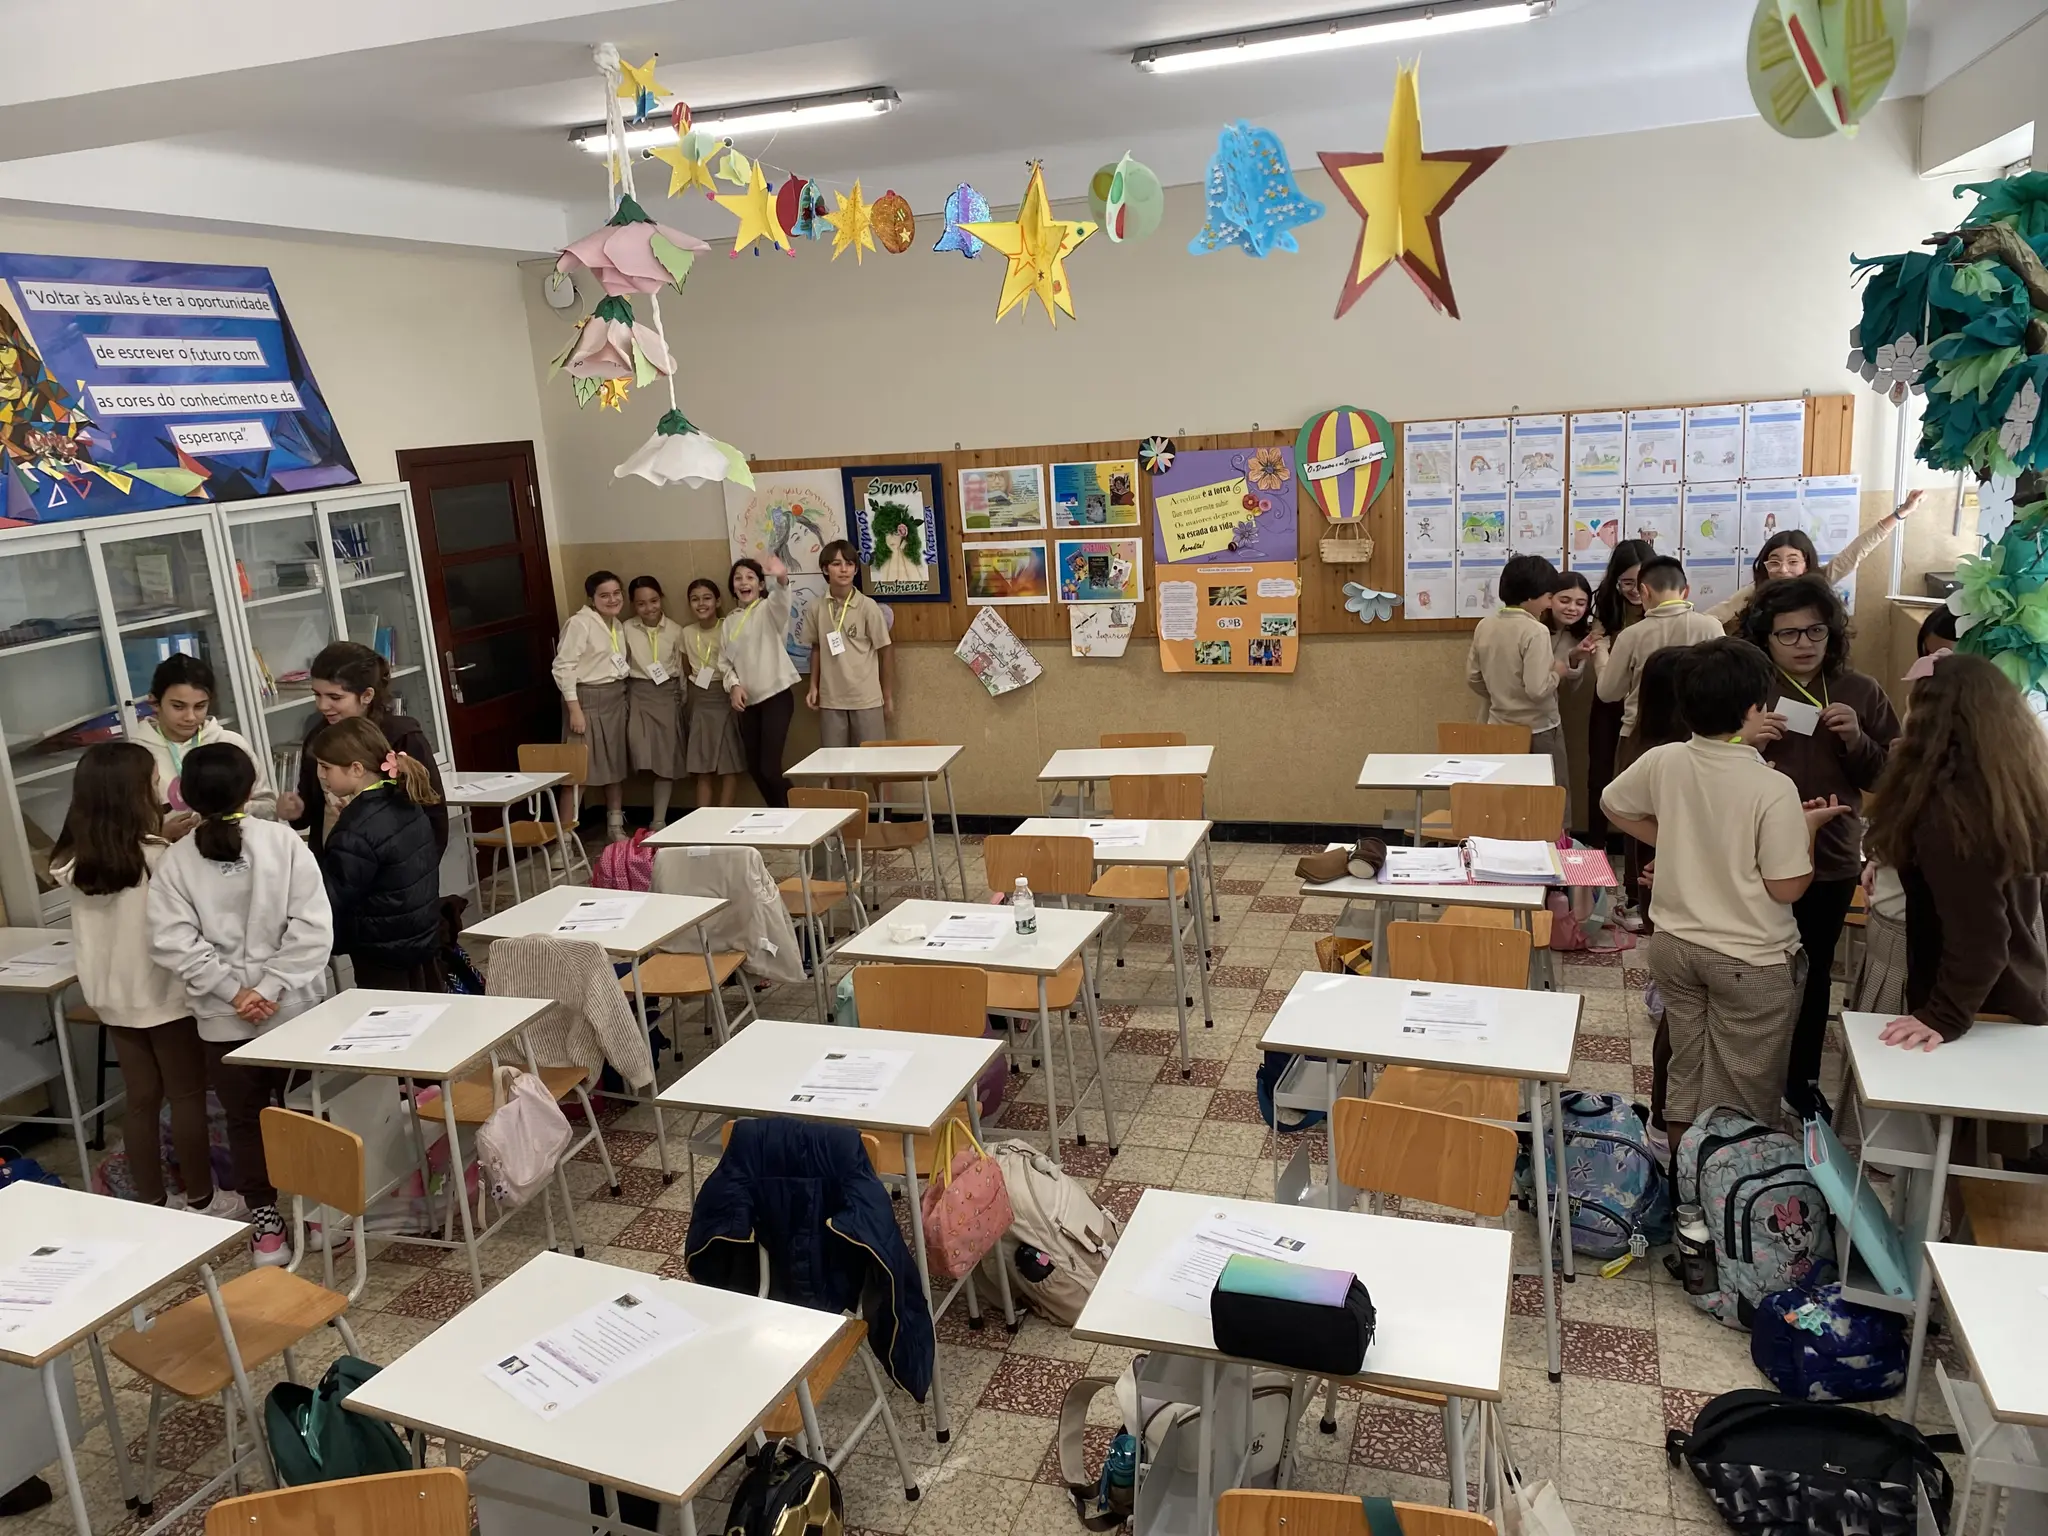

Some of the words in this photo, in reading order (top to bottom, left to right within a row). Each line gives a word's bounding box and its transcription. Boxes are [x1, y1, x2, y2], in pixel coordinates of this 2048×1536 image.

[85, 290, 101, 306] às
[103, 291, 139, 306] aulas
[142, 290, 151, 306] é
[153, 294, 173, 307] ter
[176, 296, 185, 307] a
[187, 295, 271, 312] oportunidade
[96, 345, 114, 359] de
[118, 347, 175, 361] escrever
[179, 348, 188, 360] o
[190, 347, 231, 362] futuro
[233, 350, 261, 362] com
[98, 396, 114, 409] as
[116, 395, 155, 408] cores
[157, 393, 176, 407] do
[180, 393, 269, 408] conhecimento
[270, 394, 278, 404] e
[280, 390, 296, 403] da
[868, 478, 919, 496] Somos
[1170, 493, 1201, 506] Acreditar
[1208, 489, 1213, 497] a
[1214, 484, 1231, 496] força
[1171, 509, 1182, 519] Que
[1194, 503, 1215, 514] permite
[1215, 499, 1229, 508] subir
[1174, 521, 1184, 529] Os
[1185, 517, 1212, 527] maiores
[1213, 510, 1240, 522] degraus
[855, 510, 872, 564] Somos
[923, 505, 937, 565] Natureza
[1176, 531, 1186, 540] Na
[1186, 526, 1209, 538] escada
[1209, 523, 1218, 533] da
[1219, 520, 1236, 531] vida.
[1179, 540, 1206, 553] Acredita!
[874, 579, 929, 594] Ambiente
